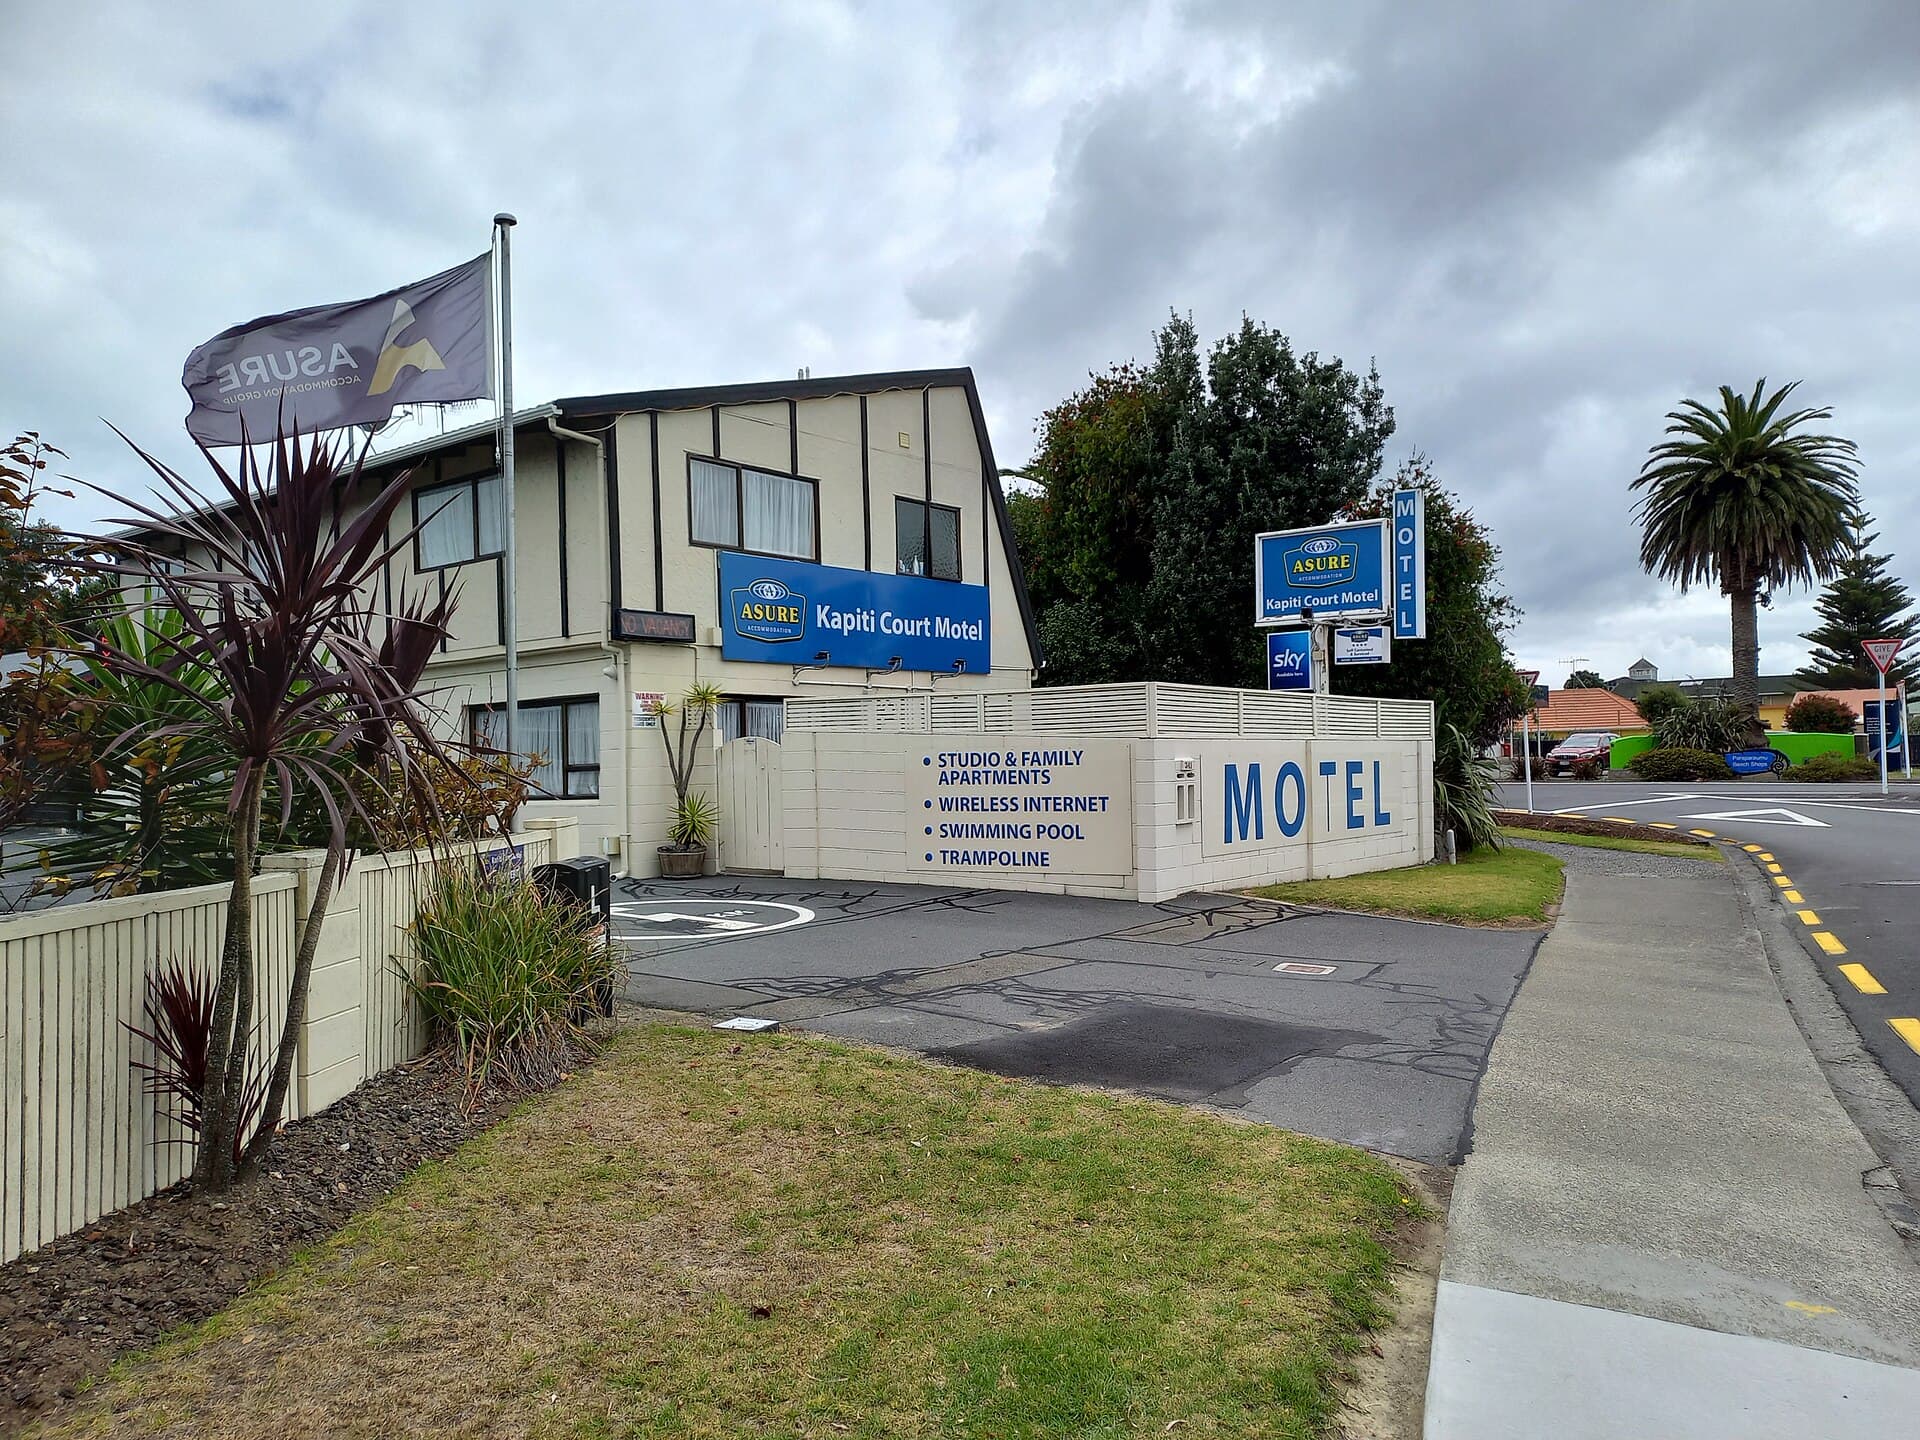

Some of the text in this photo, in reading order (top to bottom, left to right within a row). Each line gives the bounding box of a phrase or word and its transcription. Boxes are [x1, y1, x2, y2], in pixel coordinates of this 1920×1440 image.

[1292, 554, 1351, 574] ASURE
[1396, 499, 1415, 629] MOTEL
[1298, 573, 1343, 582] ACCOMMODATION
[1266, 588, 1379, 612] Kapiti Court Motel
[741, 602, 800, 623] ASURE
[747, 625, 792, 634] ACCOMMODATION
[816, 604, 983, 641] Kapiti Court Motel
[1273, 648, 1306, 671] sky
[938, 750, 1084, 768] STUDIO & FAMILY
[938, 769, 1051, 786] APARTMENTS
[938, 796, 1110, 812] WIRELESS INTERNET
[1223, 760, 1391, 844] MOTEL
[939, 823, 1085, 840] SWIMMING POOL
[939, 850, 1050, 867] TRAMPOLINE
